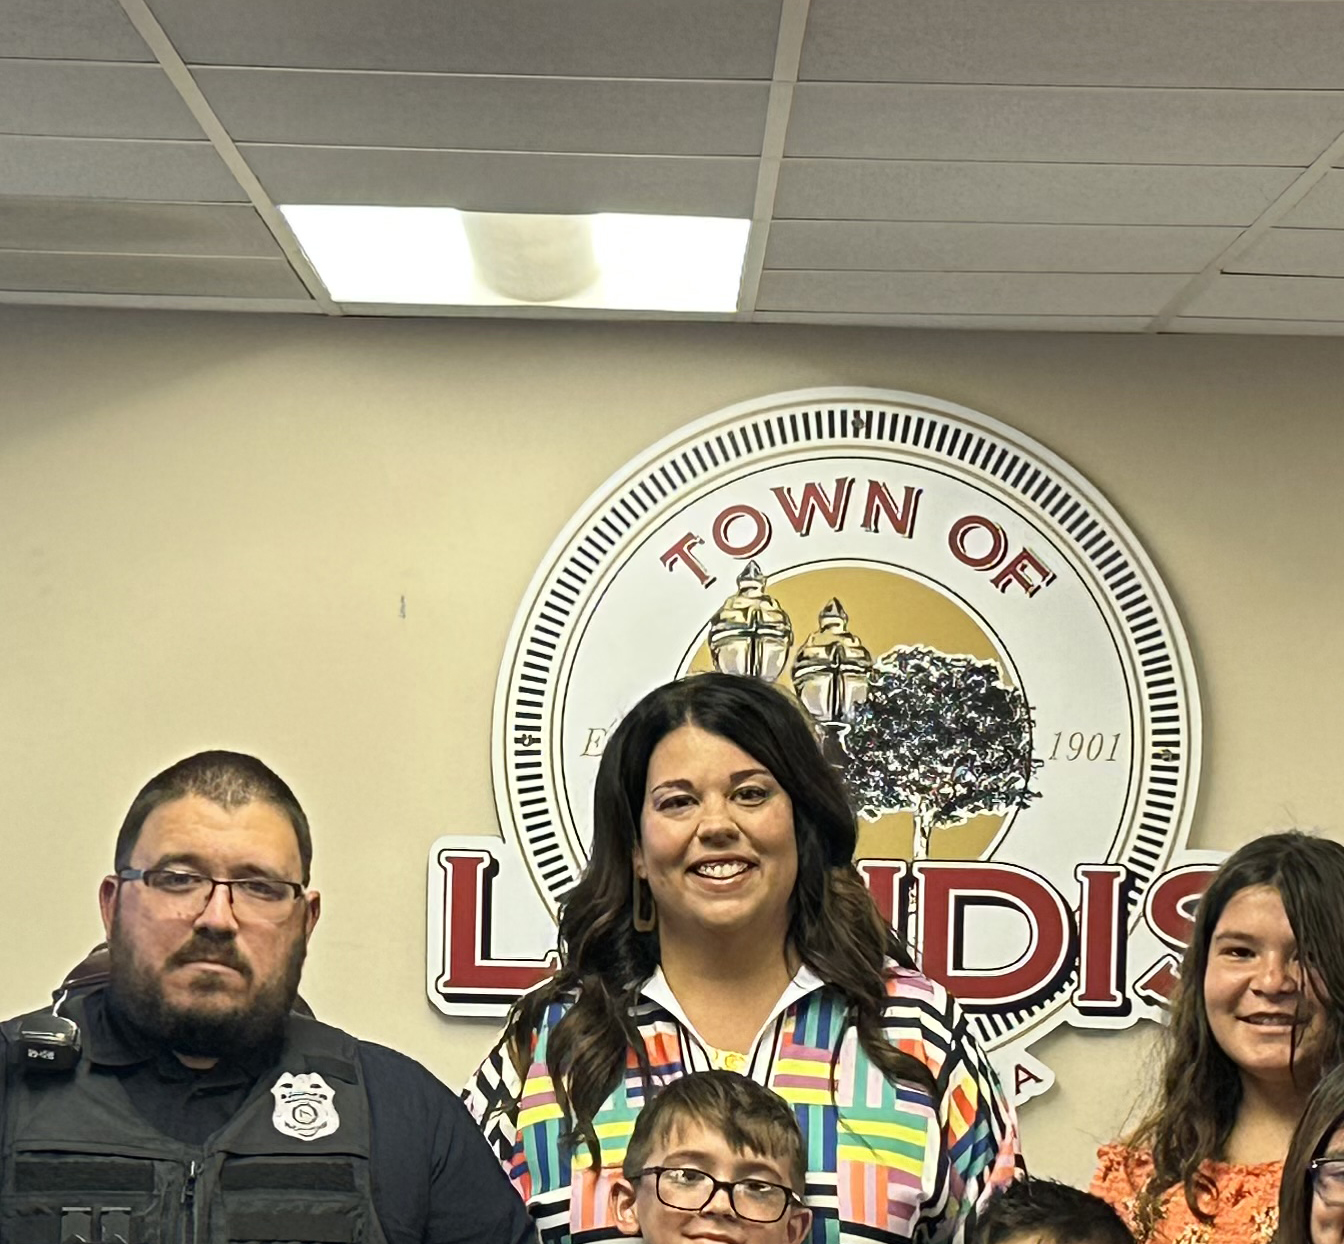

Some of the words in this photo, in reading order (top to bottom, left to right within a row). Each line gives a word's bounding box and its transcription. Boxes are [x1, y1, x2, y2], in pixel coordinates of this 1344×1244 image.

[659, 477, 923, 590] TOWN
[948, 514, 1057, 599] OF
[1048, 731, 1121, 761] 1901
[440, 853, 1218, 1006] LDI
